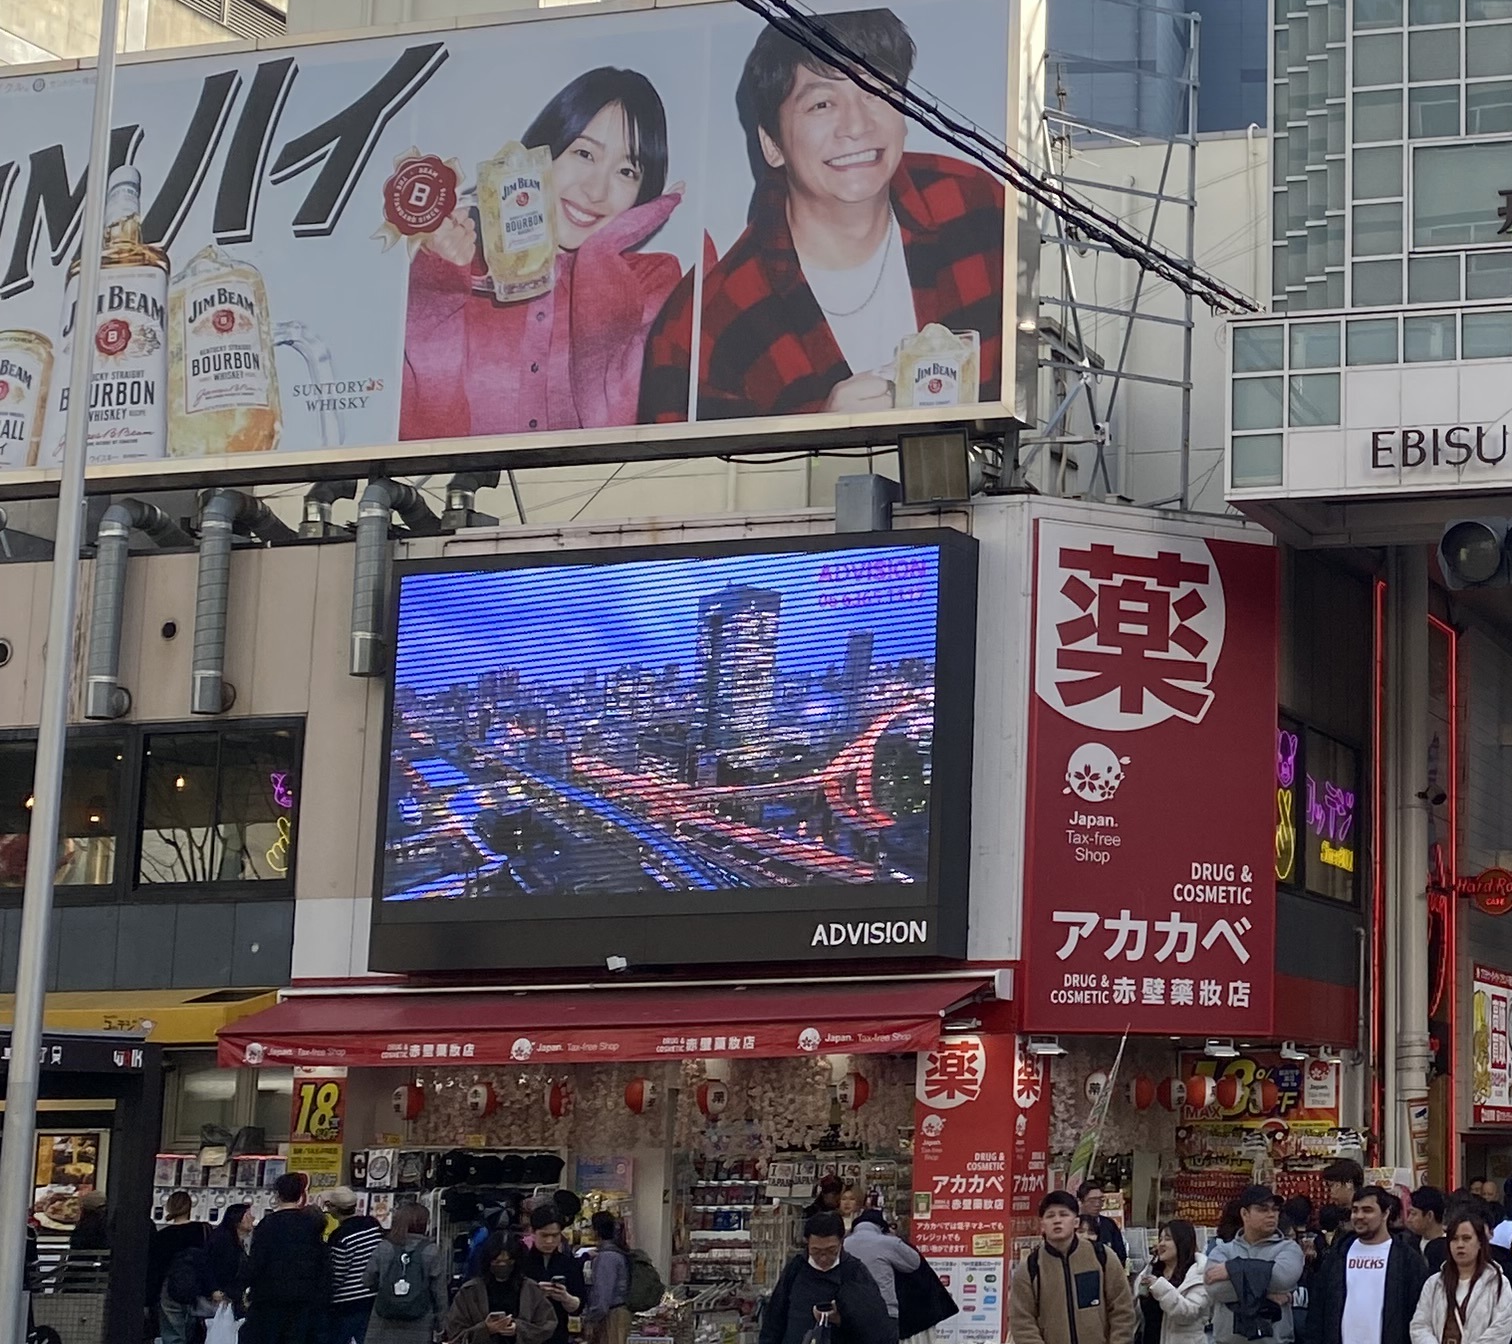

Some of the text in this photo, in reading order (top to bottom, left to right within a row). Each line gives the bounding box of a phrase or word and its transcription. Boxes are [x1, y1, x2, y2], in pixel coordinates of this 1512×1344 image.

[408, 182, 431, 207] B
[502, 177, 541, 201] JIM BEAM
[505, 214, 543, 233] BOURBON
[107, 285, 166, 332] BEAM
[188, 287, 255, 324] JIM BEAM
[192, 352, 260, 376] BOURBON
[915, 362, 956, 383] JIM BEAM
[59, 380, 155, 412] BURBON
[306, 396, 369, 412] WHISKY
[0, 419, 25, 441] ALL
[1372, 425, 1509, 470] EBISU
[1055, 542, 1215, 720] 薬
[1069, 811, 1119, 828] Japan.
[1066, 830, 1121, 846] Tax-free
[1075, 847, 1110, 864] Shop
[1191, 862, 1253, 882] DRUG &
[1173, 883, 1253, 905] COSMETIC
[1457, 877, 1496, 894] Hard
[1052, 909, 1252, 965] アカカベ
[1064, 974, 1109, 988] DRUG &
[1050, 989, 1110, 1004] COSMETIC
[891, 1032, 912, 1042] Shop
[599, 1042, 620, 1053] Shop
[923, 1040, 981, 1101] 薬
[296, 1081, 340, 1138] 18
[966, 1161, 1005, 1172] COSMETIC
[974, 1152, 997, 1162] DRUG
[931, 1174, 1005, 1194] アカカベ
[1348, 1258, 1385, 1270] DUCKS
